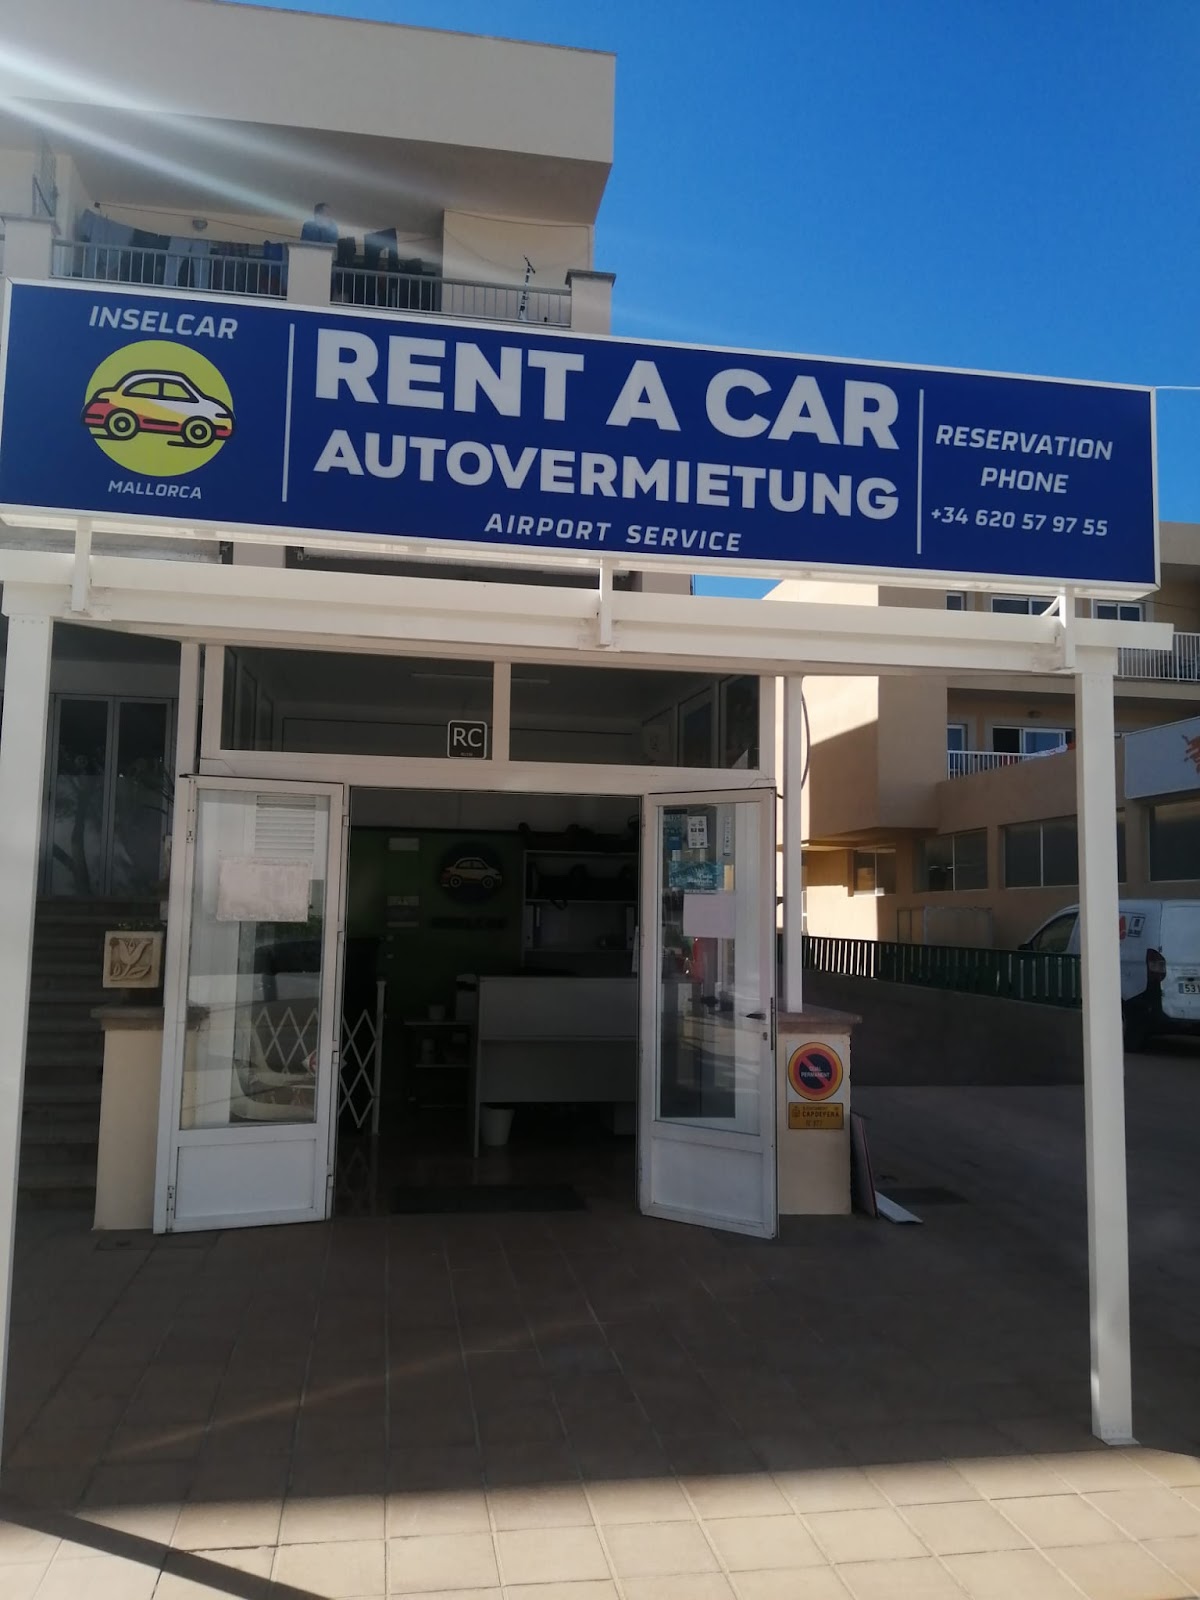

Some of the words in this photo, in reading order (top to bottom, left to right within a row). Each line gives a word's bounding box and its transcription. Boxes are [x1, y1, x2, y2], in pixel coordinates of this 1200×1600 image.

[89, 305, 238, 339] INSELCAR
[315, 328, 585, 421] RENT
[605, 360, 681, 431] A
[705, 368, 899, 450] CAR
[935, 424, 1113, 460] RESERVATION
[108, 480, 202, 500] MALLORCA
[313, 429, 899, 520] AUTOVERMIETUNG
[980, 467, 1069, 494] PHONE
[484, 513, 612, 541] AIRPORT
[626, 524, 742, 553] SERVICE
[931, 506, 968, 524] +34
[975, 509, 1015, 528] 620
[1022, 513, 1047, 530] 57
[1052, 516, 1077, 533] 97
[1082, 519, 1107, 536] 55
[453, 727, 482, 747] RC
